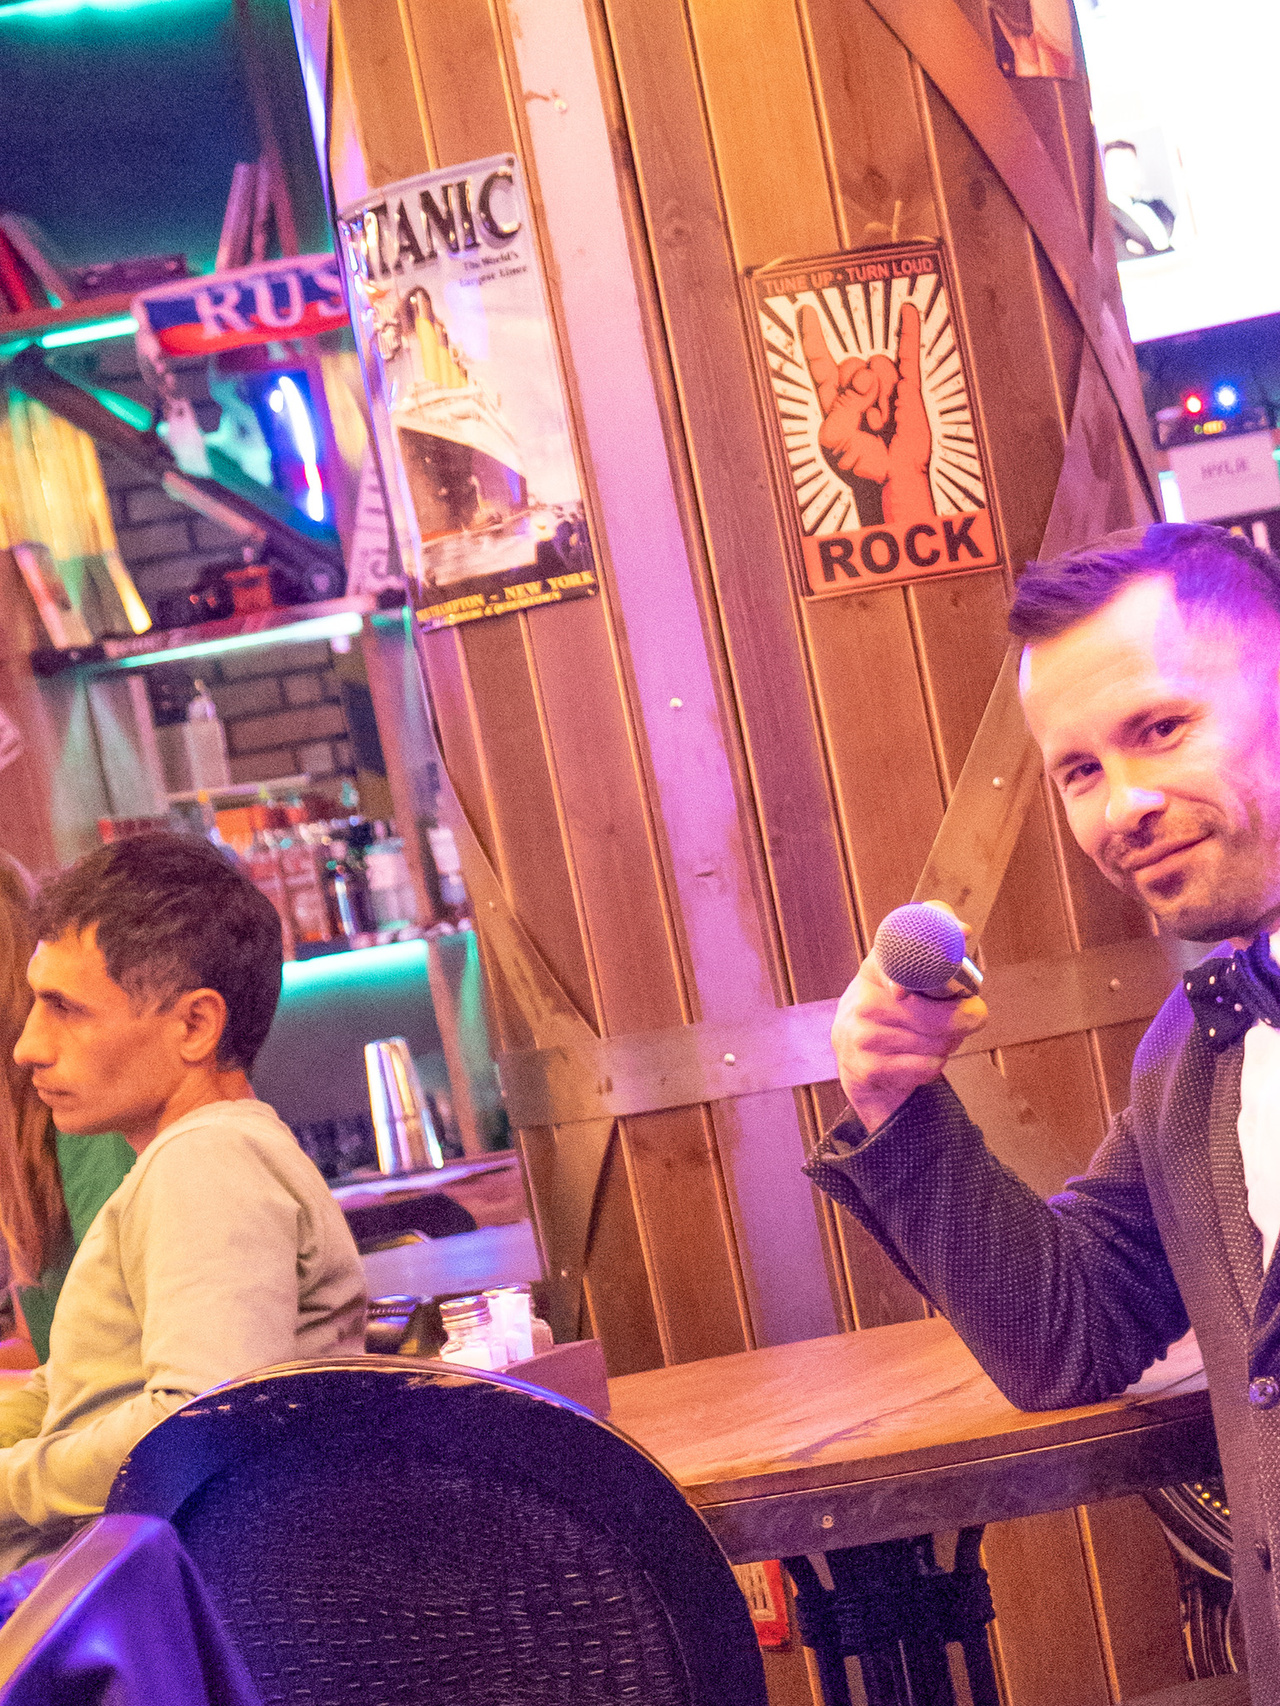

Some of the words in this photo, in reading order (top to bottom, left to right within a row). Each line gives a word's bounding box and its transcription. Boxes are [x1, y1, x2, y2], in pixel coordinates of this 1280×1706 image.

[763, 274, 808, 295] TUNE
[810, 270, 834, 289] UP
[845, 263, 890, 282] TURN
[891, 257, 934, 276] LOUD
[818, 515, 984, 582] ROCK
[503, 580, 543, 601] NEW
[546, 570, 595, 591] YORK
